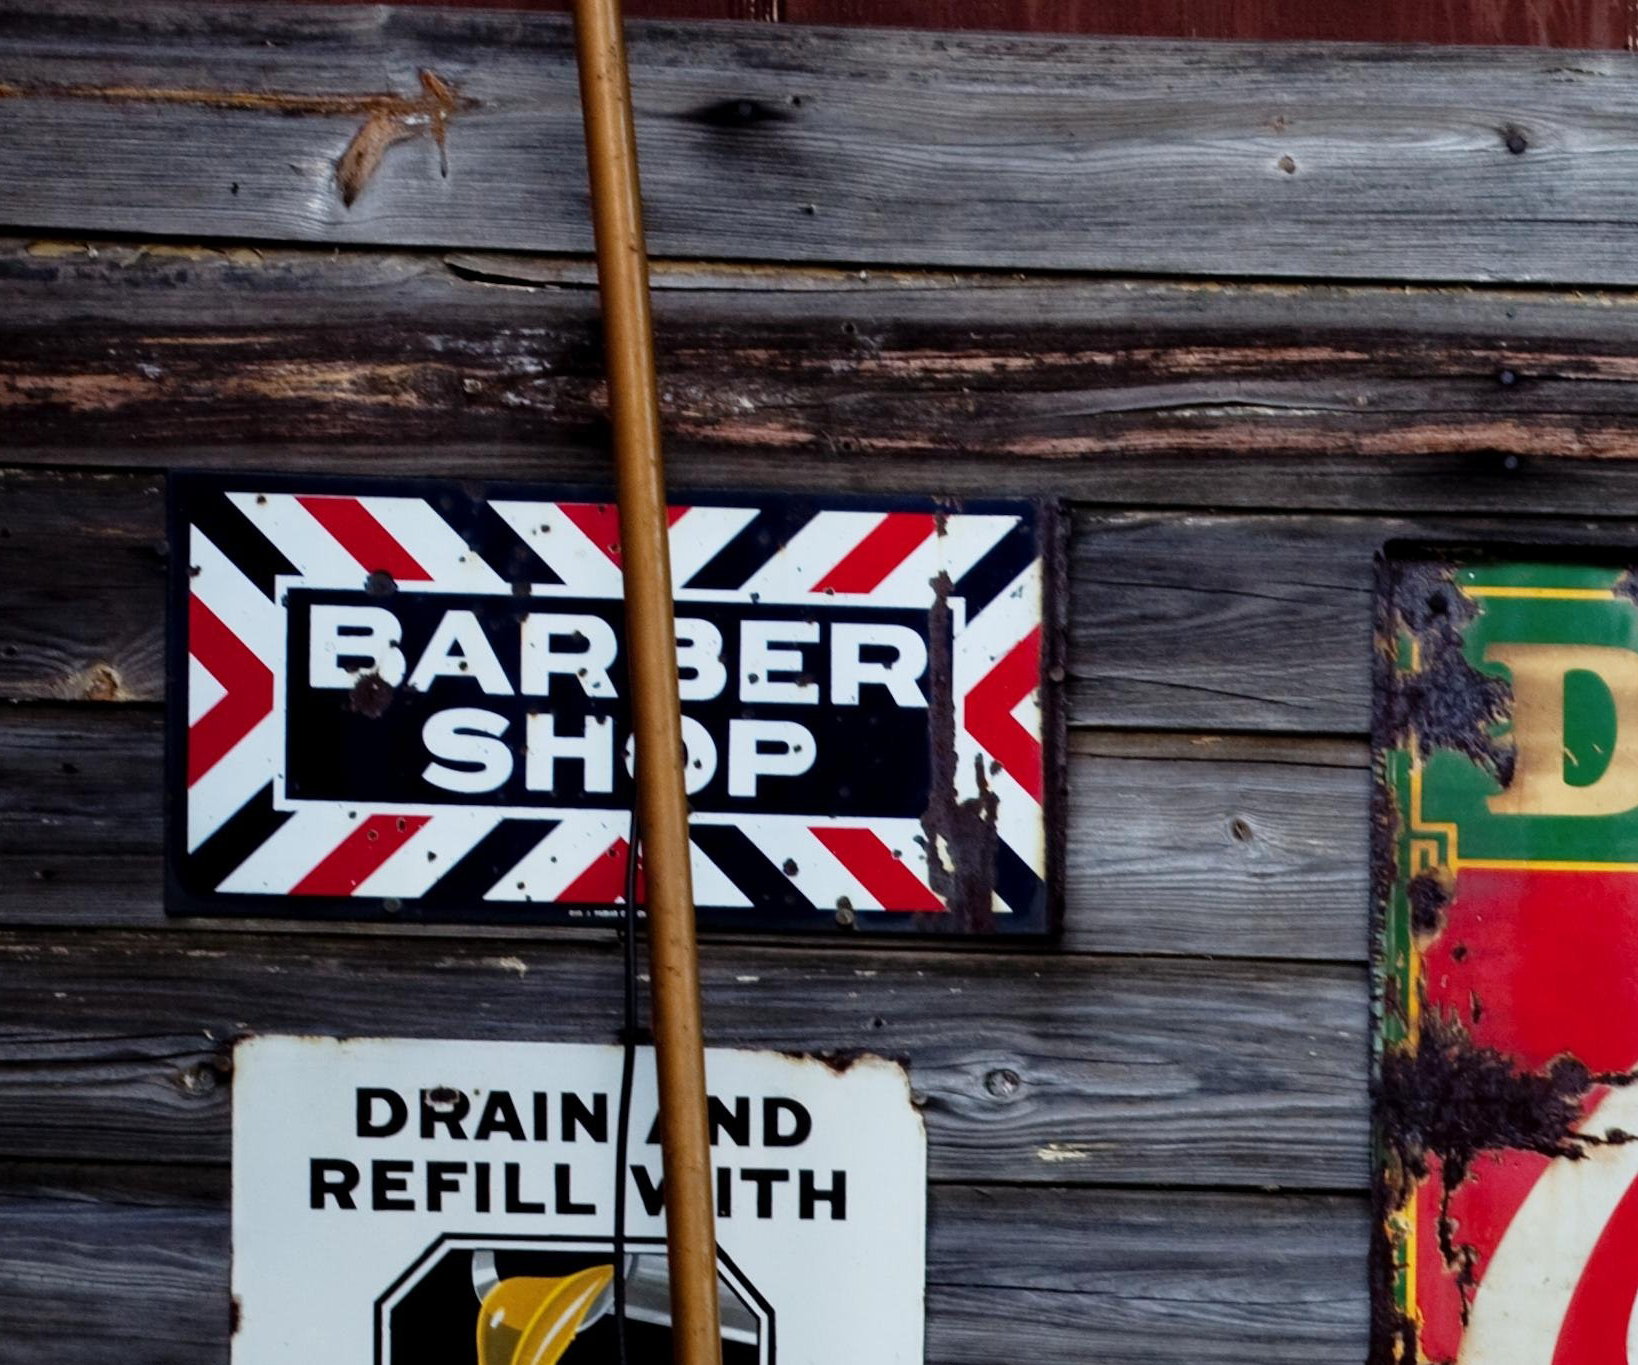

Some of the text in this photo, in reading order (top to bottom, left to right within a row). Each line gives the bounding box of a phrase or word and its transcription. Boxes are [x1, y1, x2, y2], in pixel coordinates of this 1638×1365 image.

[309, 603, 929, 709] BARBER
[355, 1085, 813, 1148] DRAIN ND
[308, 1157, 598, 1217] REFILL
